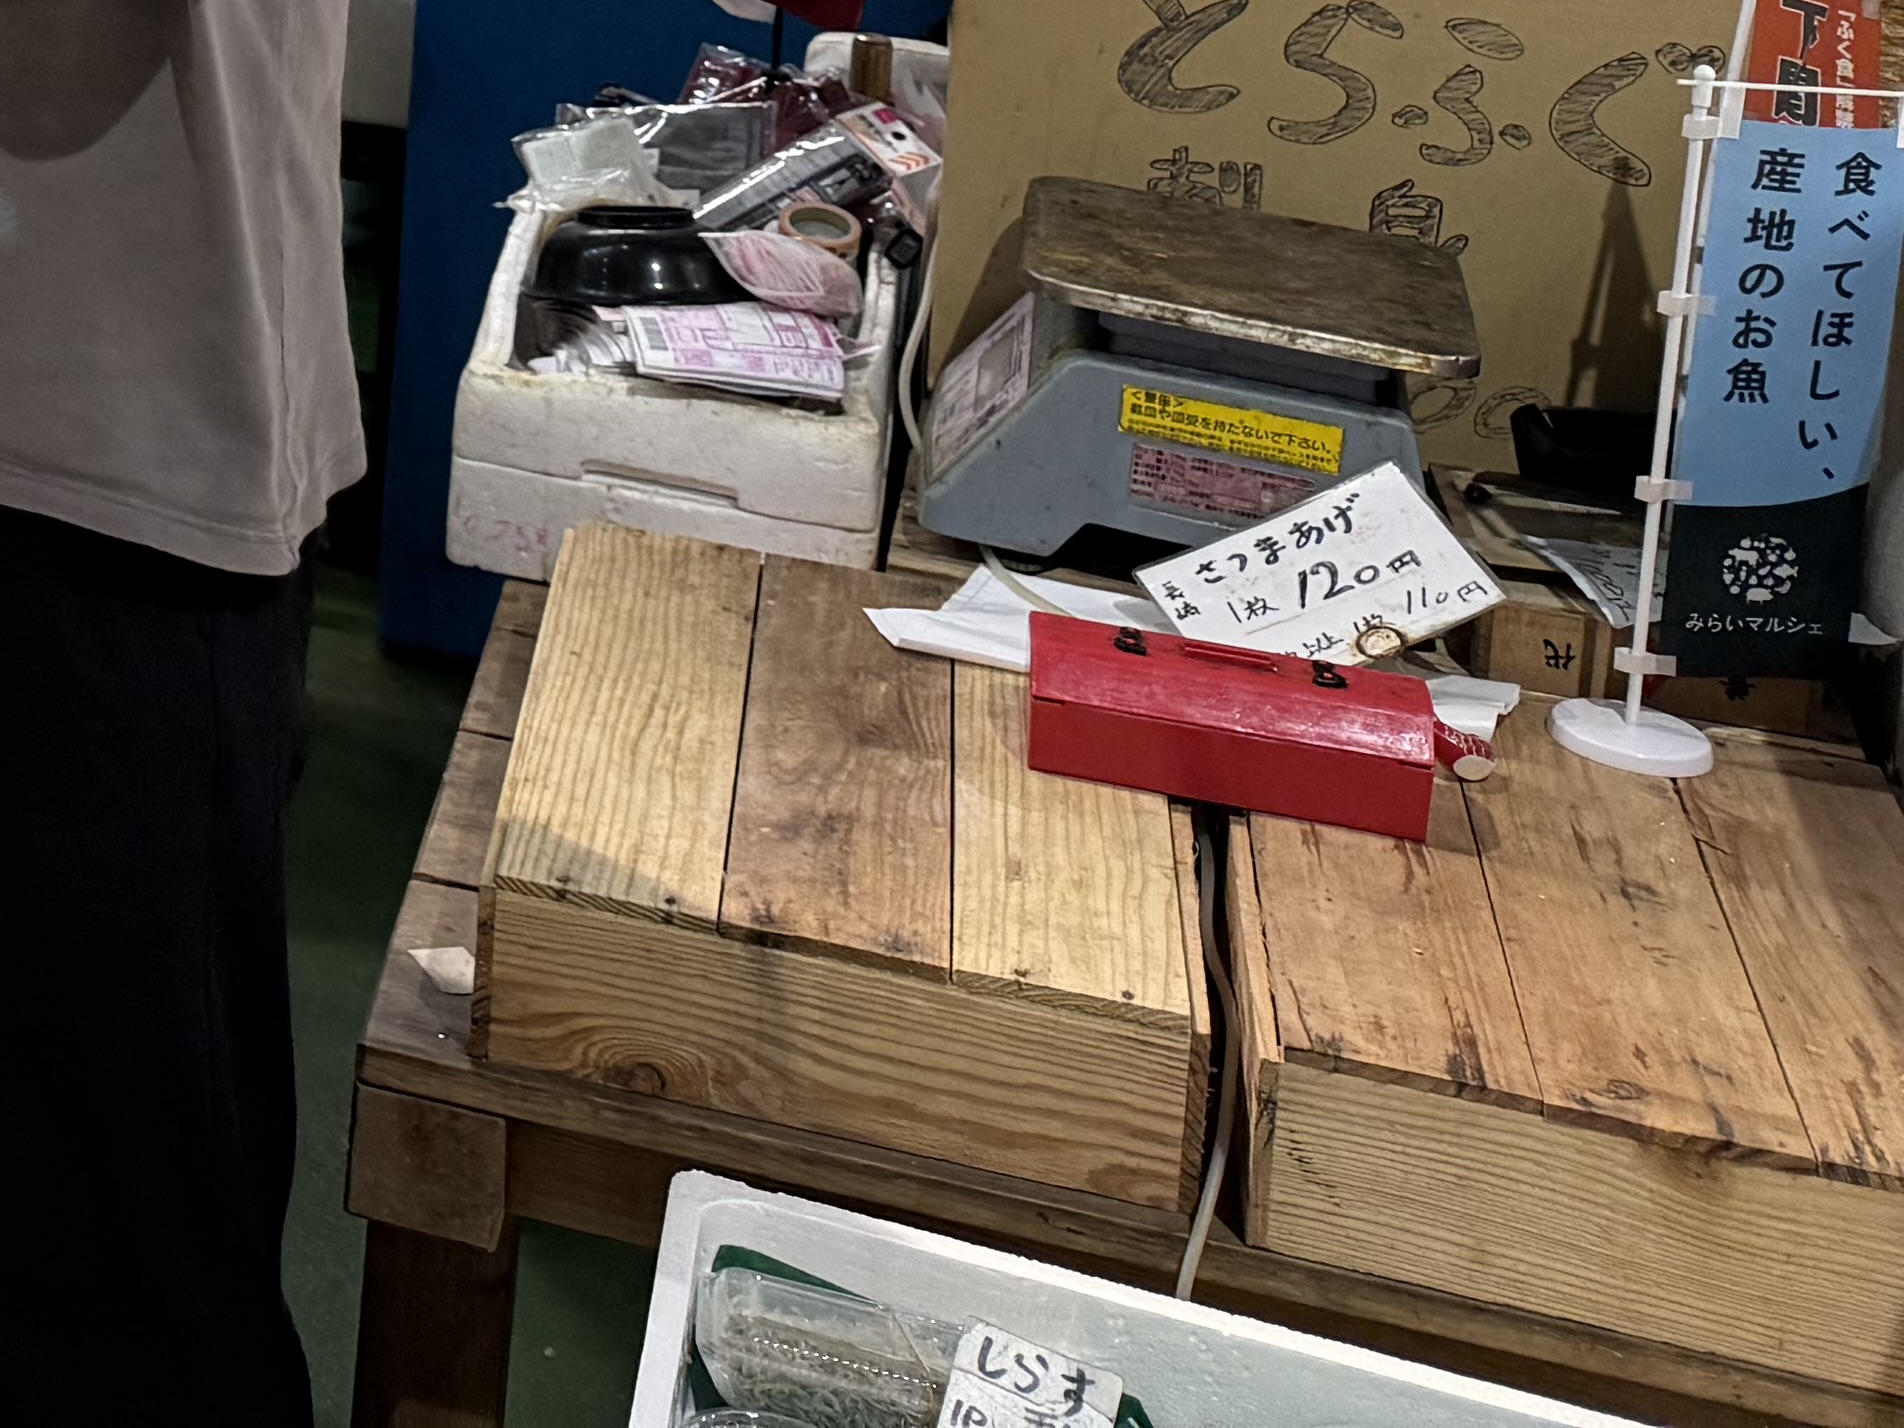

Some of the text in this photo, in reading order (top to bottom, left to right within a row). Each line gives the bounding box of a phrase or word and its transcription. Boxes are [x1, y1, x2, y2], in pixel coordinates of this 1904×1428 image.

[1723, 147, 1805, 406] 産地のお魚
[1797, 152, 1883, 482] 食べてほしい、
[1194, 492, 1361, 586] さつまあげ
[1297, 548, 1423, 610] 120円
[1405, 579, 1489, 615] 110円
[1685, 611, 1824, 637] みらいマルシェ
[977, 1336, 1096, 1418] しらす
